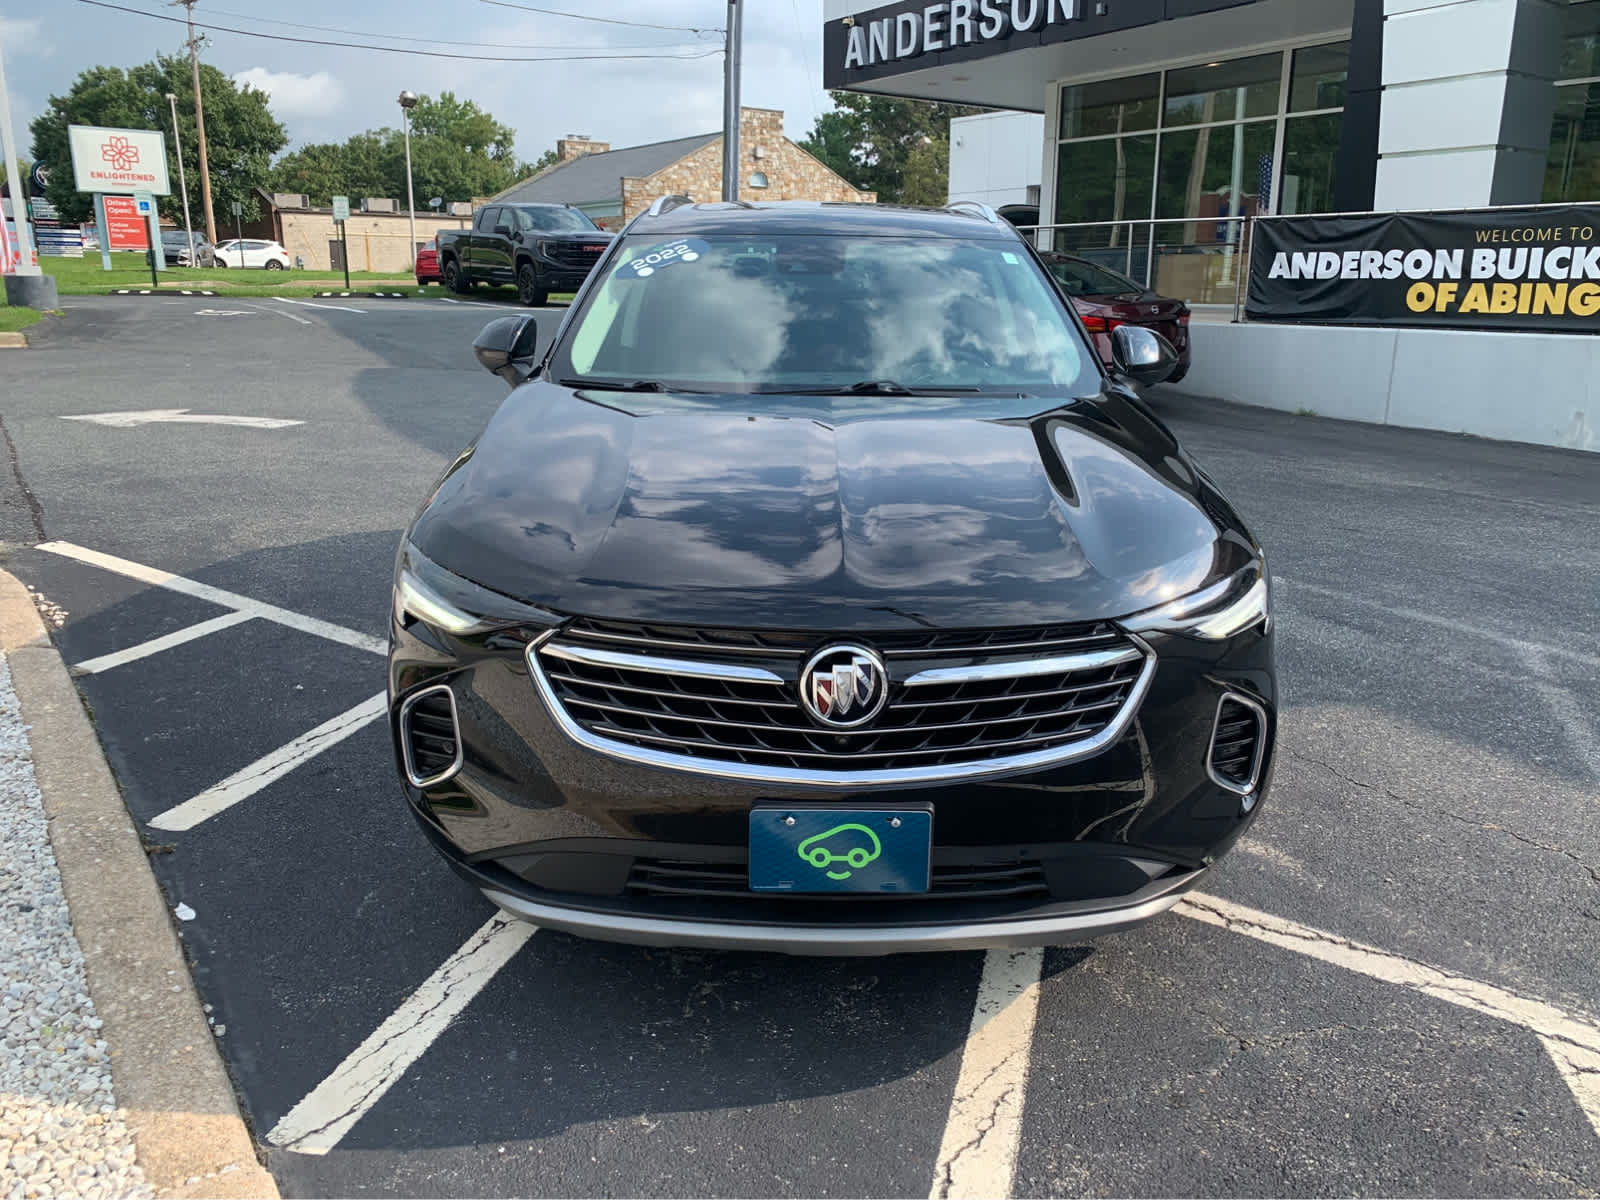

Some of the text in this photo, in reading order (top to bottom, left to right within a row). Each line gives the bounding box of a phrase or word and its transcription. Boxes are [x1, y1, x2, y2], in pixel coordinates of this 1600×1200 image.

[845, 0, 1074, 68] ANDERSON
[90, 171, 156, 182] ENLIGHTENED
[1475, 226, 1593, 243] WELCOME TO
[630, 244, 693, 271] 2022
[1268, 245, 1600, 280] ANDERSON BUICK
[1406, 281, 1600, 316] OF ABING
